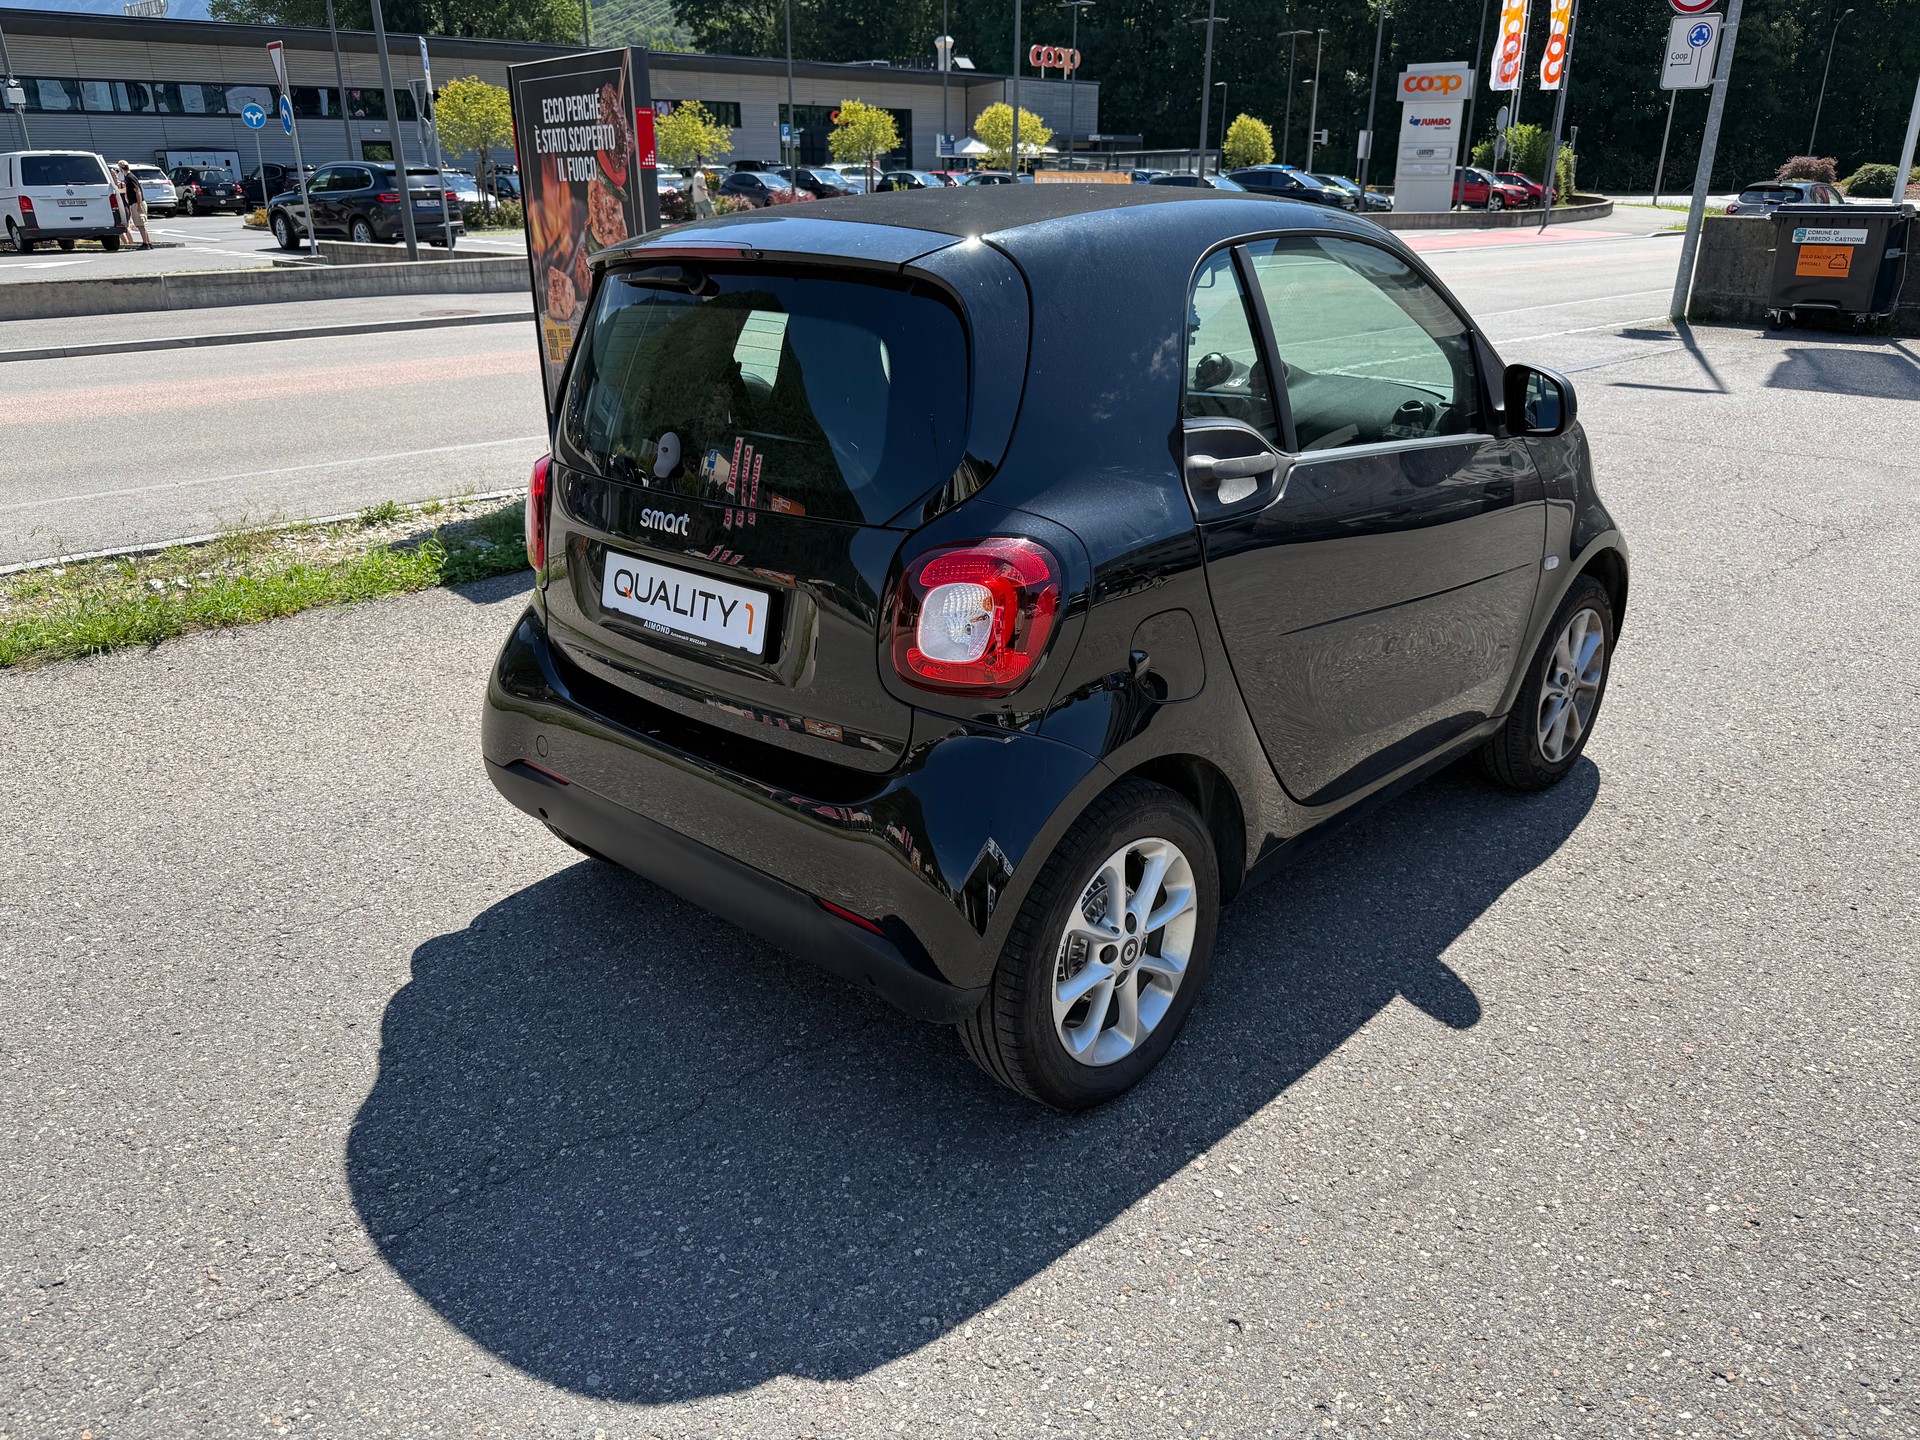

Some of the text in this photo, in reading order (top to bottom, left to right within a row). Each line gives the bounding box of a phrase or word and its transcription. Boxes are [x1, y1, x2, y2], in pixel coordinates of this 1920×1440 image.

[1029, 44, 1081, 74] coop
[1671, 52, 1688, 61] Coop
[1404, 75, 1462, 95] coop
[542, 88, 602, 124] ECCO PERCHÉ
[1420, 118, 1451, 126] JUMBO
[534, 124, 616, 154] È STATO SCOPERTO
[557, 156, 597, 182] IL FUOCO
[640, 508, 691, 536] smart
[614, 568, 754, 634] QUALITY 1
[643, 620, 670, 635] AIMOND
